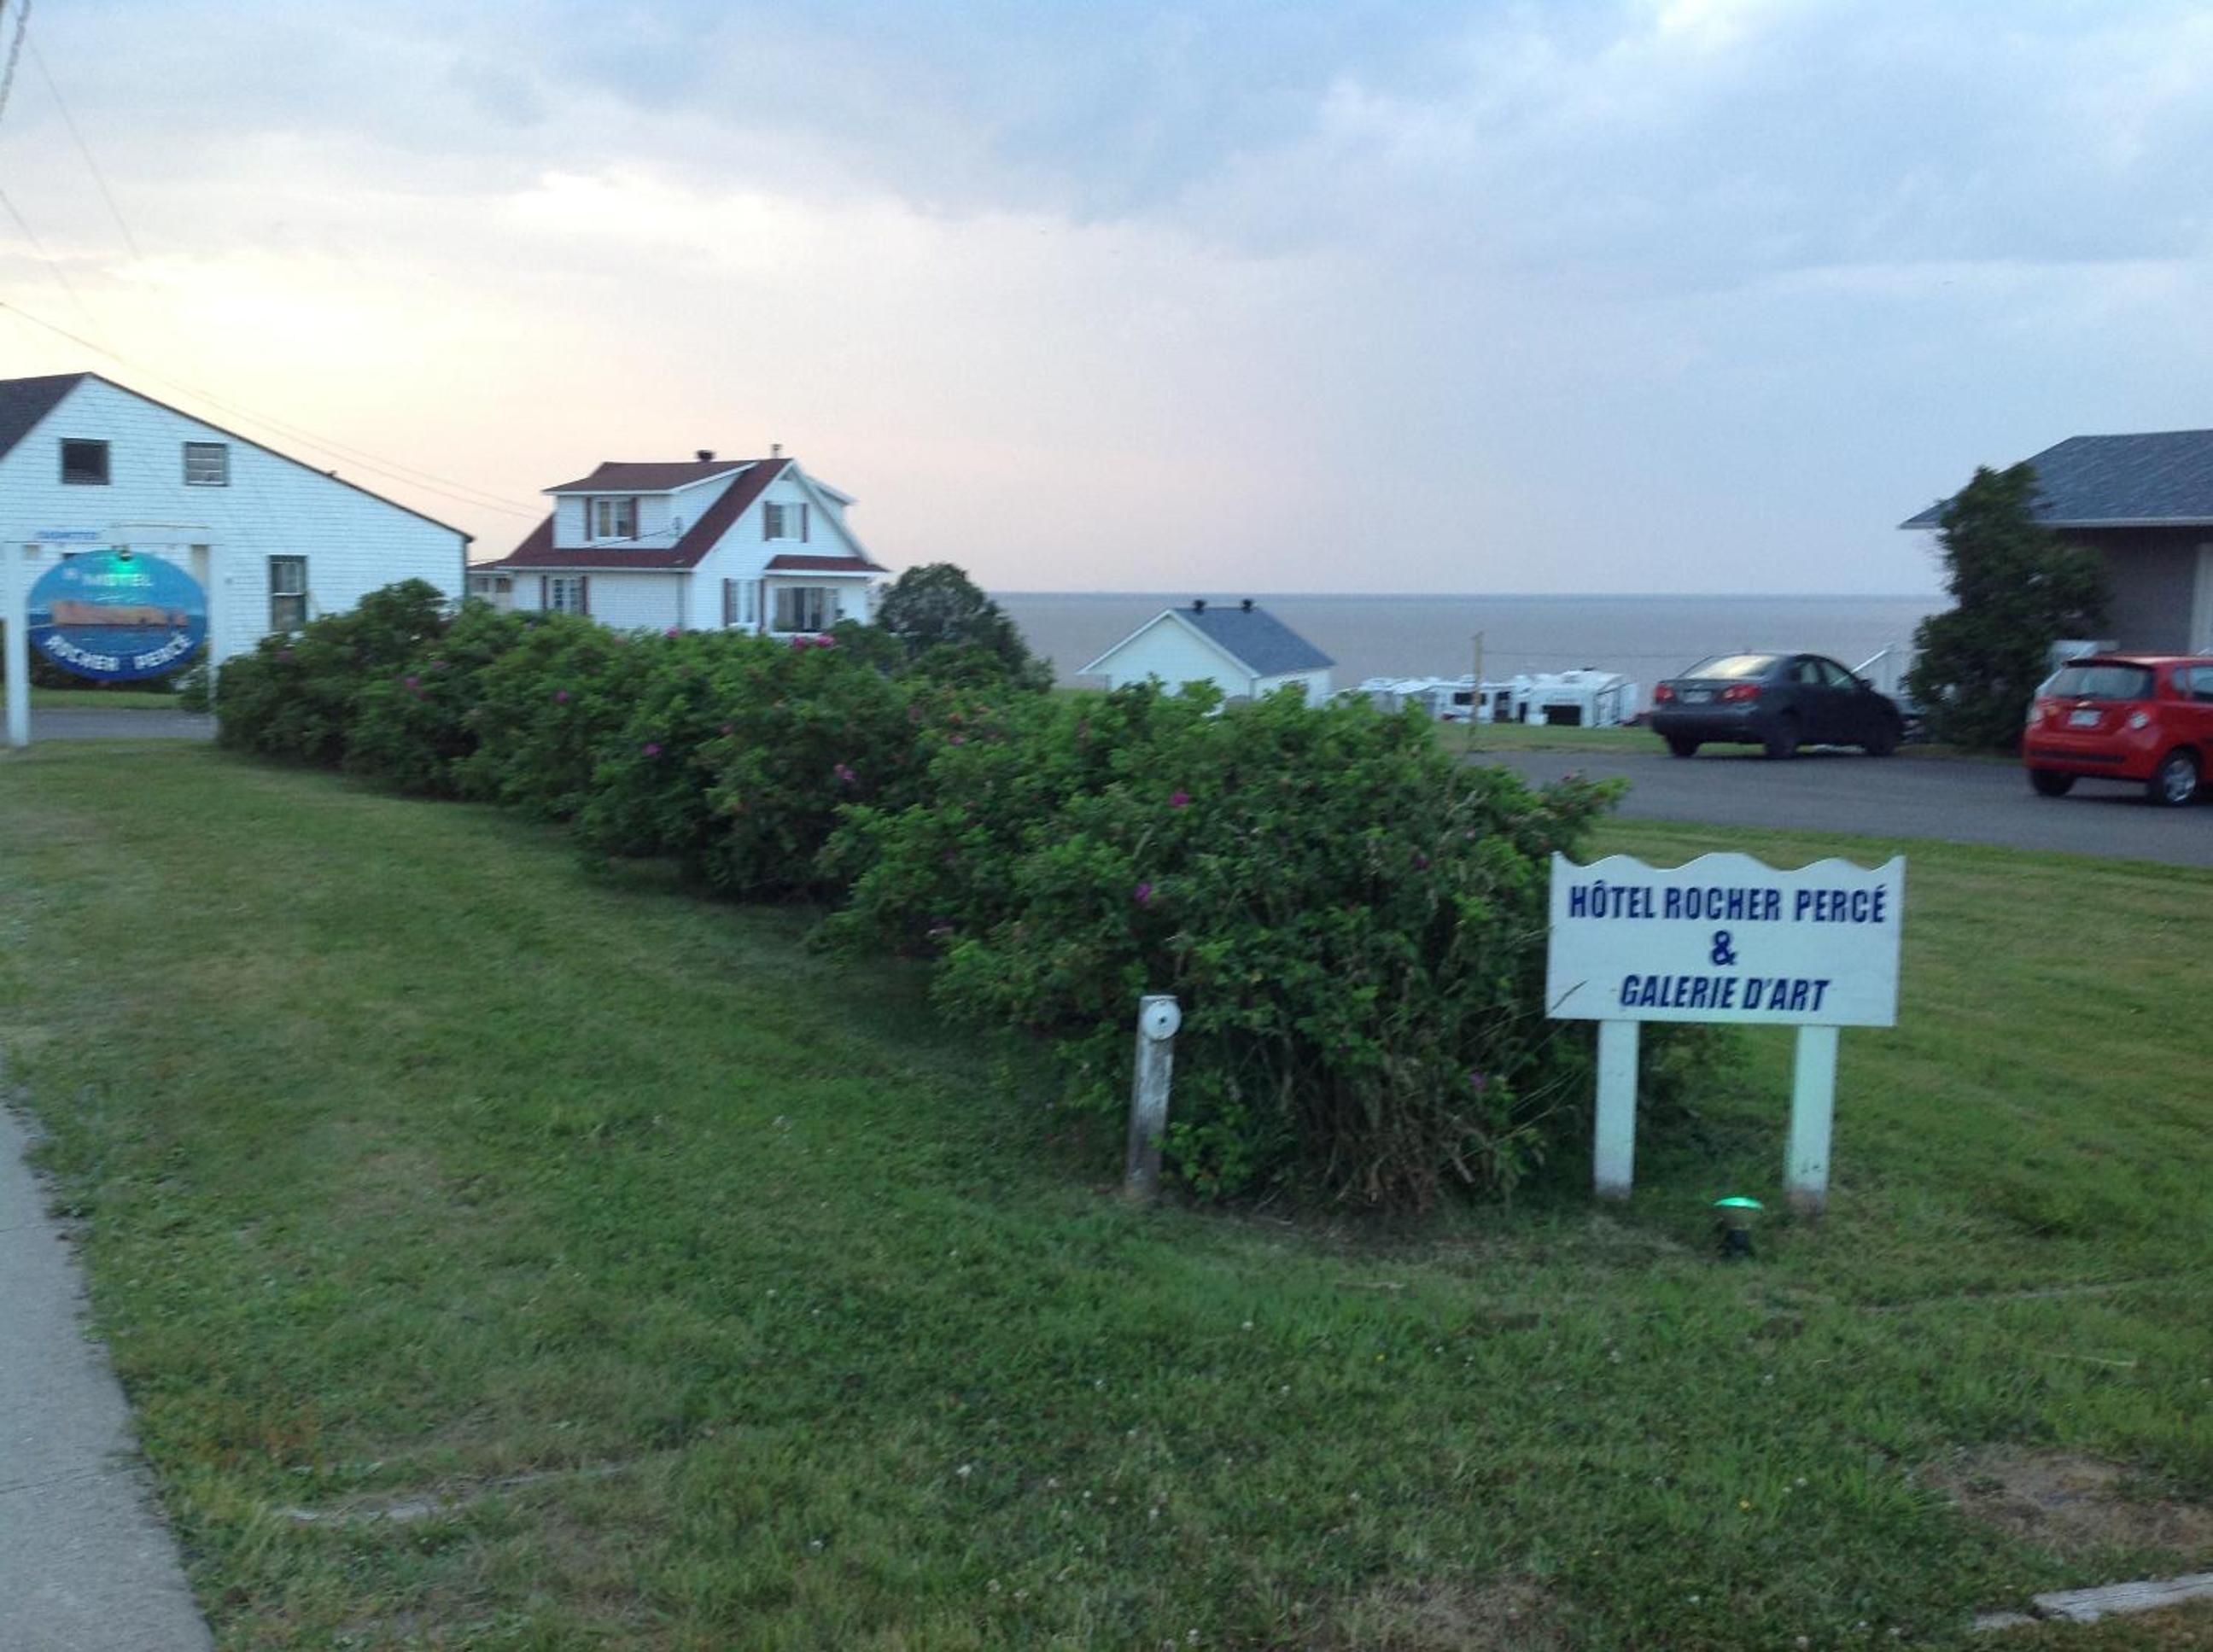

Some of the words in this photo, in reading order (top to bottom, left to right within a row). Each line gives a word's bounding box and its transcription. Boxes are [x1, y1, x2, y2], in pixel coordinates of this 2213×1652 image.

[1663, 885, 1781, 921] ROCHER
[1794, 883, 1888, 923] PERCÉ
[1709, 930, 1737, 966] &
[1620, 974, 1737, 1009] GALERIE
[1742, 978, 1831, 1012] D'ART
